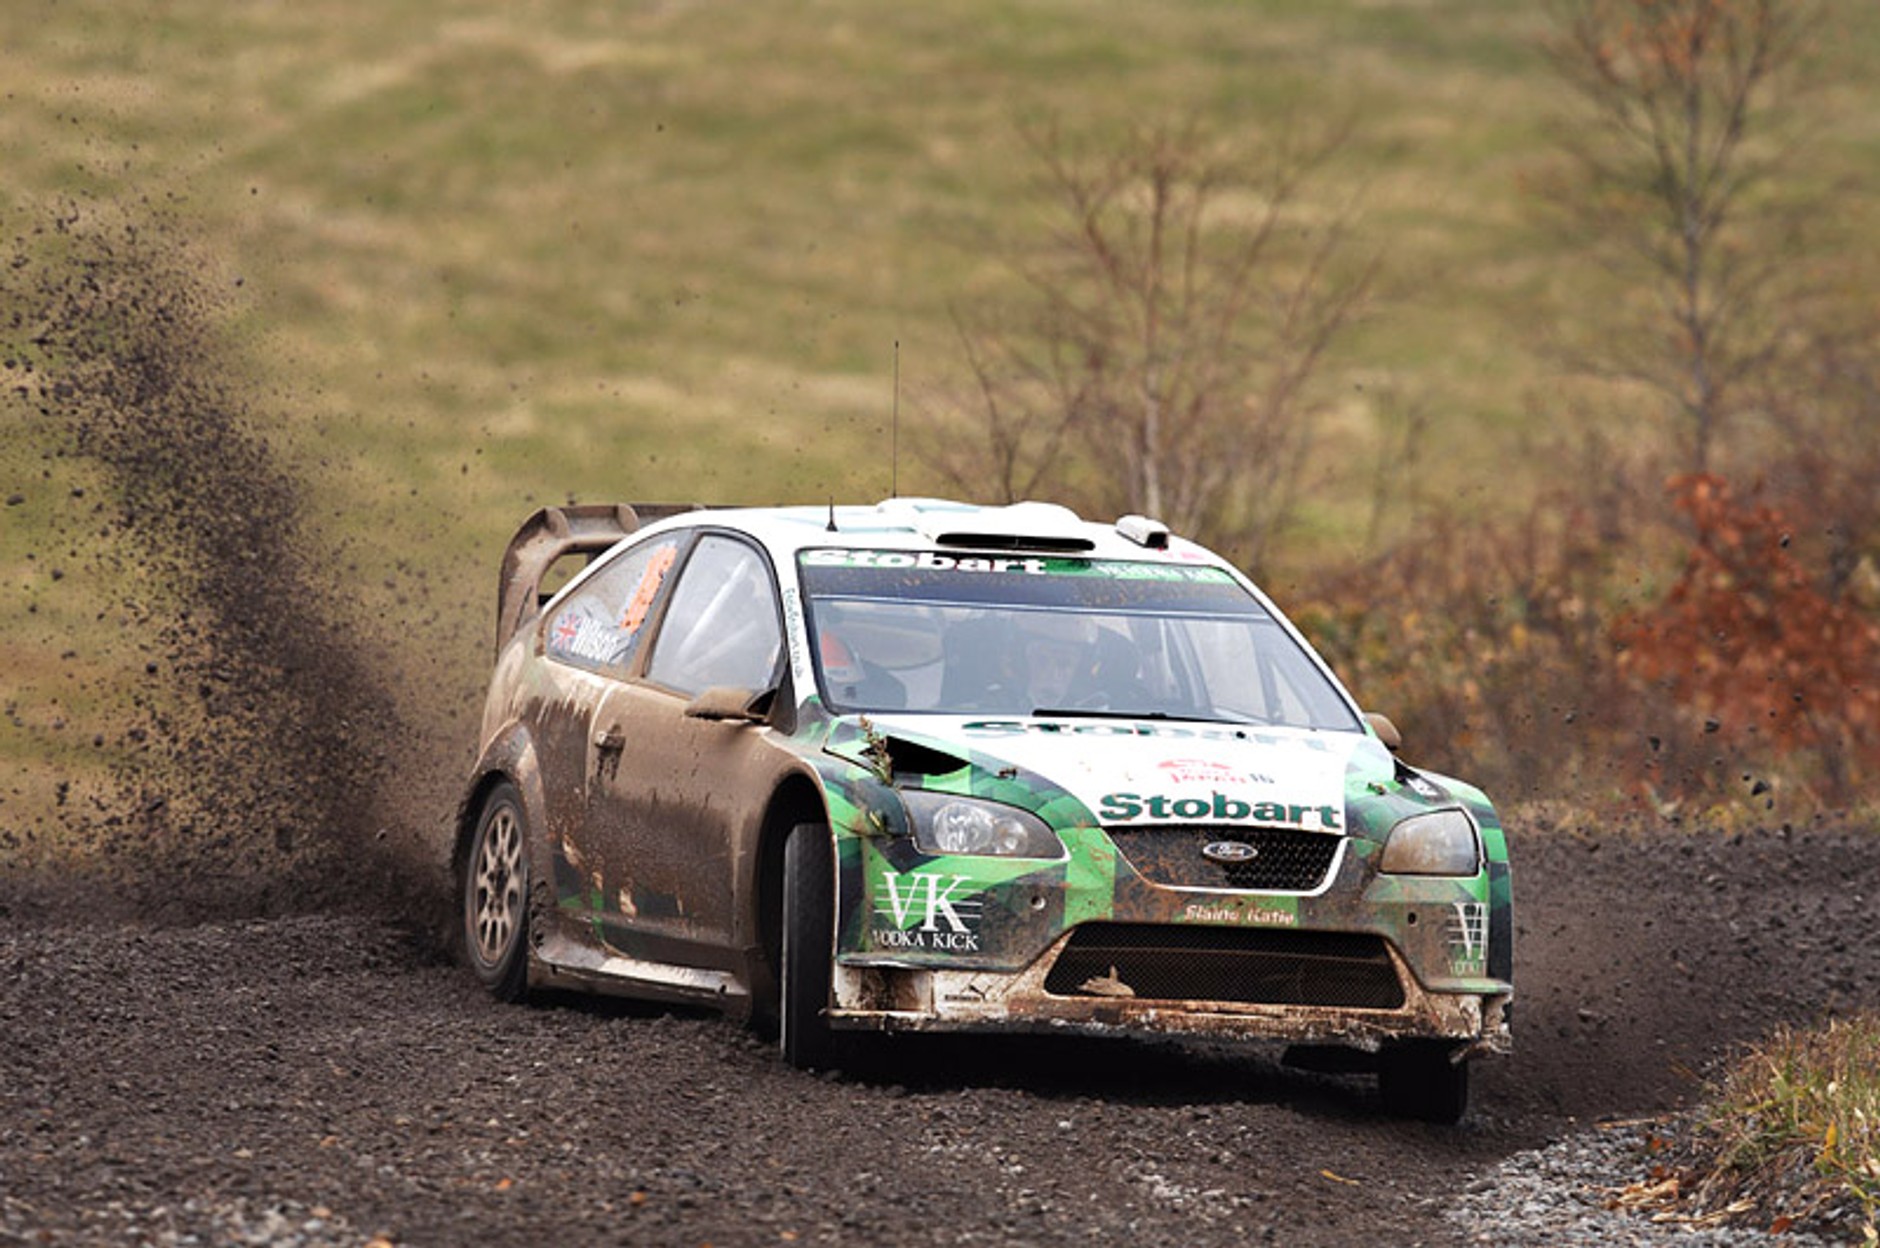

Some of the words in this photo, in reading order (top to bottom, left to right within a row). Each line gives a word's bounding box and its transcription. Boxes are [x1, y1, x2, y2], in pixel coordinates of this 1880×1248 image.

[805, 550, 1047, 575] Stobart
[1099, 791, 1341, 829] Stobart
[881, 870, 974, 935] VK
[872, 929, 926, 948] VODKA
[932, 932, 980, 951] KICK
